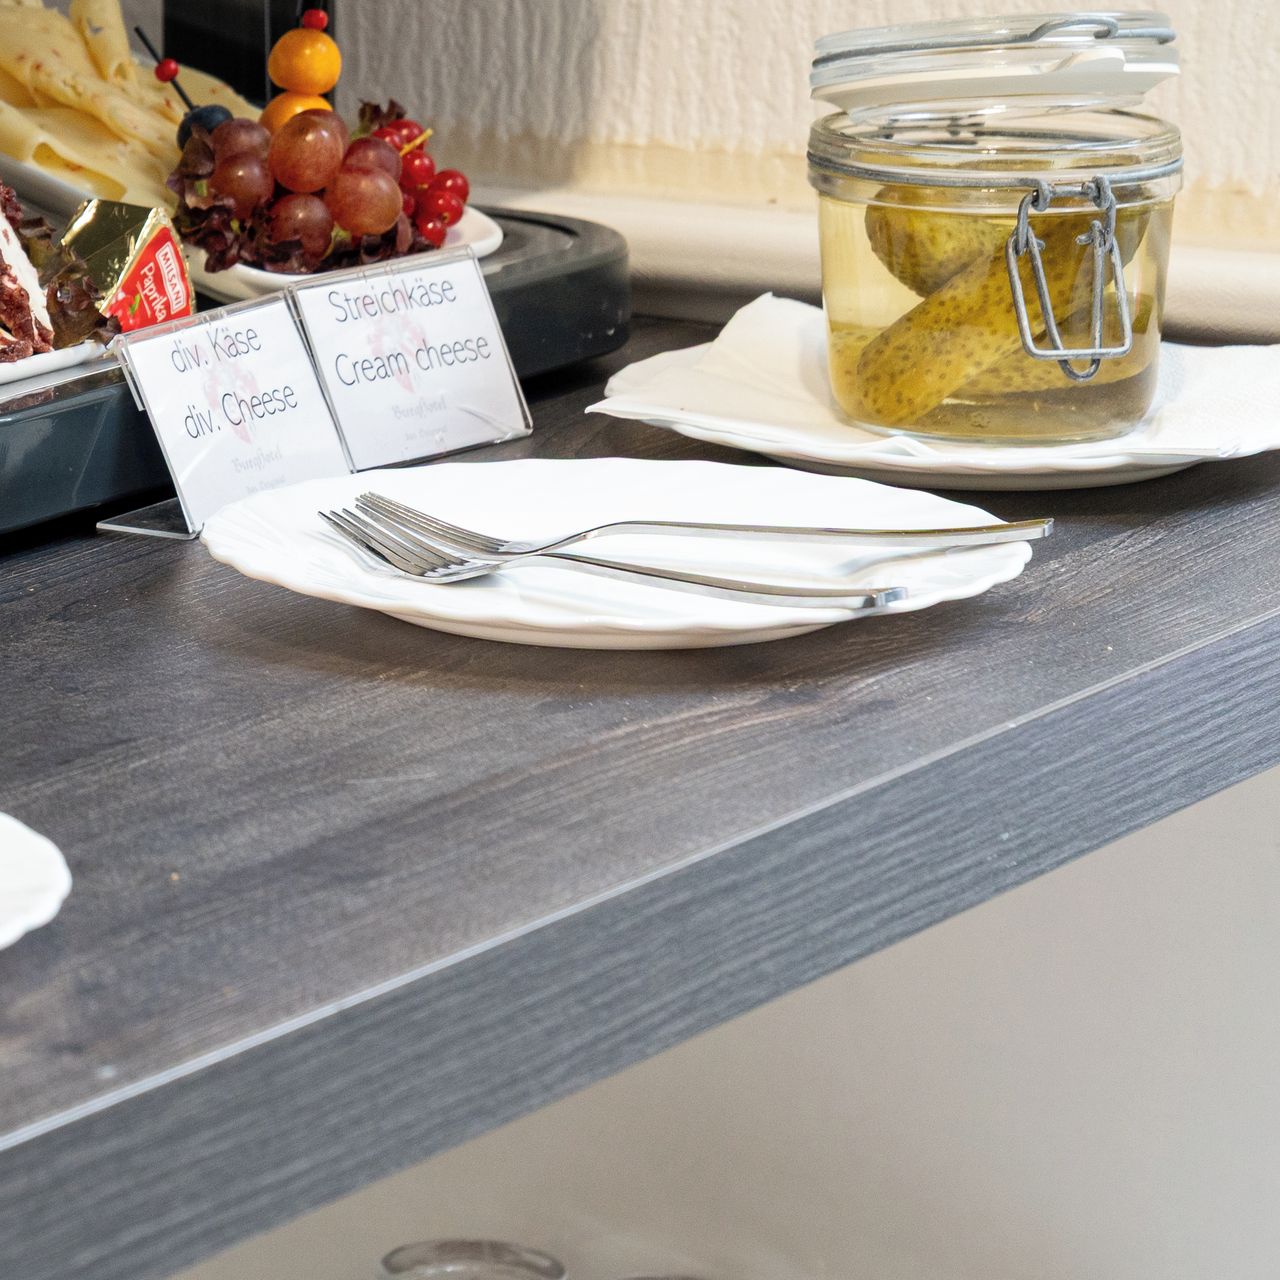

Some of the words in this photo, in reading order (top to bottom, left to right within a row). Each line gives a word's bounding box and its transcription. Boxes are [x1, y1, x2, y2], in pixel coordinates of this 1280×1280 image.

[140, 261, 168, 324] Paprika
[161, 251, 183, 309] MILSANI
[328, 277, 457, 323] Streichkäse
[171, 339, 209, 373] div.
[206, 325, 262, 361] Käse
[335, 351, 410, 387] Cream
[415, 335, 491, 372] cheese
[184, 404, 221, 439] div.
[222, 385, 298, 427] Cheese
